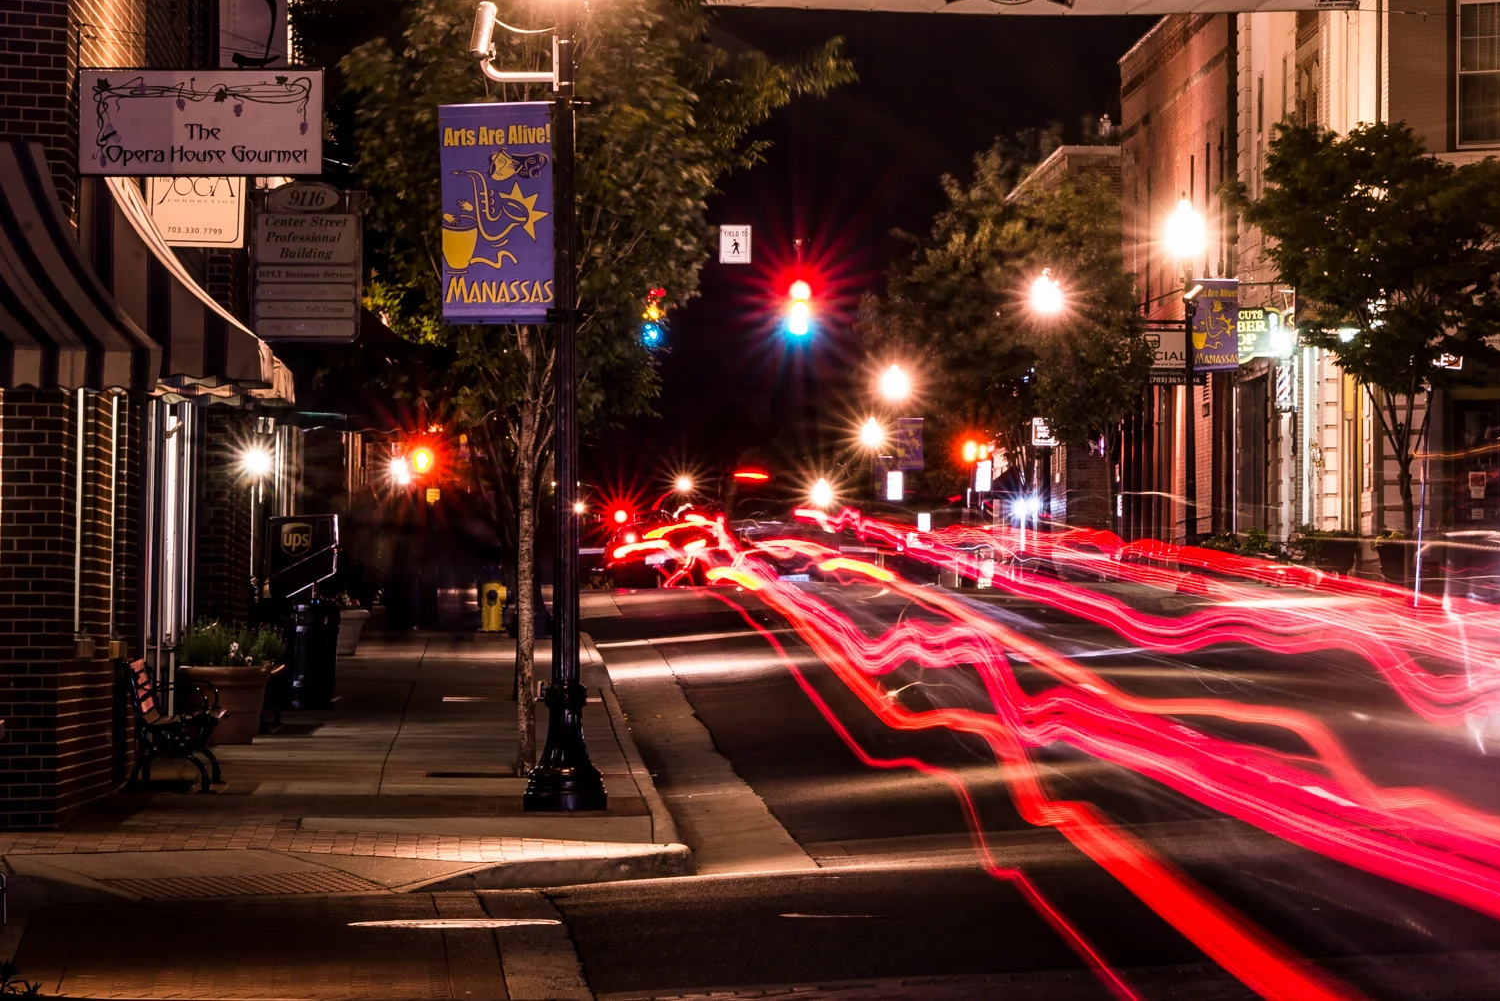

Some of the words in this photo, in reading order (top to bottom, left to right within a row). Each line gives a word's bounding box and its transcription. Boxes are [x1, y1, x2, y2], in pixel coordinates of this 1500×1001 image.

[184, 123, 221, 140] The
[443, 127, 476, 146] Arts
[478, 126, 505, 146] Are
[507, 123, 551, 145] Alive!
[105, 145, 165, 166] Opera
[170, 145, 226, 163] House
[231, 145, 309, 163] Gourmet
[288, 189, 328, 207] 9116
[264, 215, 307, 228] Center
[310, 214, 349, 228] Street
[166, 226, 223, 235] 703.330.7799
[741, 230, 749, 238] TO
[265, 231, 342, 244] Professional
[279, 247, 334, 260] Building
[285, 270, 320, 279] Business
[322, 270, 354, 279] Services
[445, 275, 554, 304] MANASSAS
[1207, 289, 1219, 298] Are
[1219, 288, 1238, 298] Alive!
[322, 305, 345, 315] Group
[1238, 310, 1264, 320] CUTS
[1238, 320, 1269, 333] BER
[1238, 333, 1257, 346] OP
[1153, 351, 1186, 361] CIAL
[1194, 352, 1239, 365] MANASSAS
[1149, 376, 1167, 384] (703)
[283, 533, 310, 552] ups
